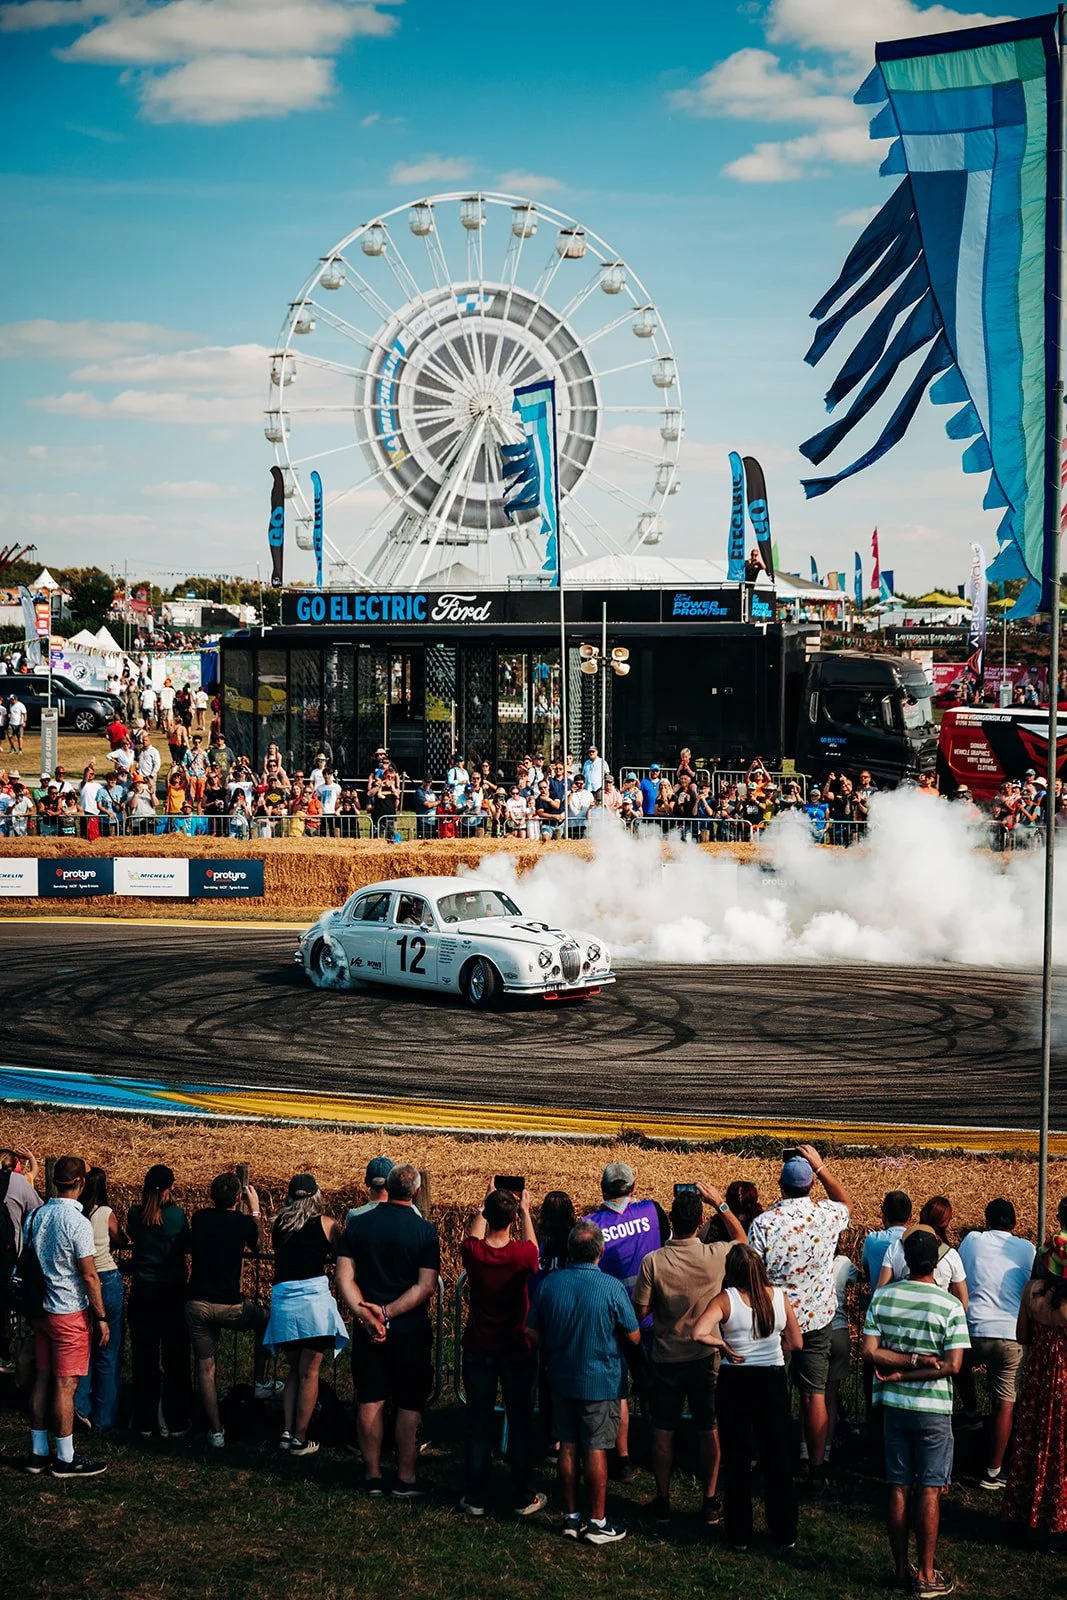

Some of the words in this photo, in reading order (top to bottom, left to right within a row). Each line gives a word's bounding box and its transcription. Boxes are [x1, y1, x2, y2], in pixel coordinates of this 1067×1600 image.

[380, 346, 400, 434] MICHELIN
[296, 596, 326, 621] GO
[330, 595, 427, 620] ELECTRIC
[431, 593, 492, 621] Ford
[63, 870, 96, 880] protyre
[214, 870, 246, 881] protyre
[397, 935, 426, 975] 12
[602, 1217, 650, 1242] SCOUTS
